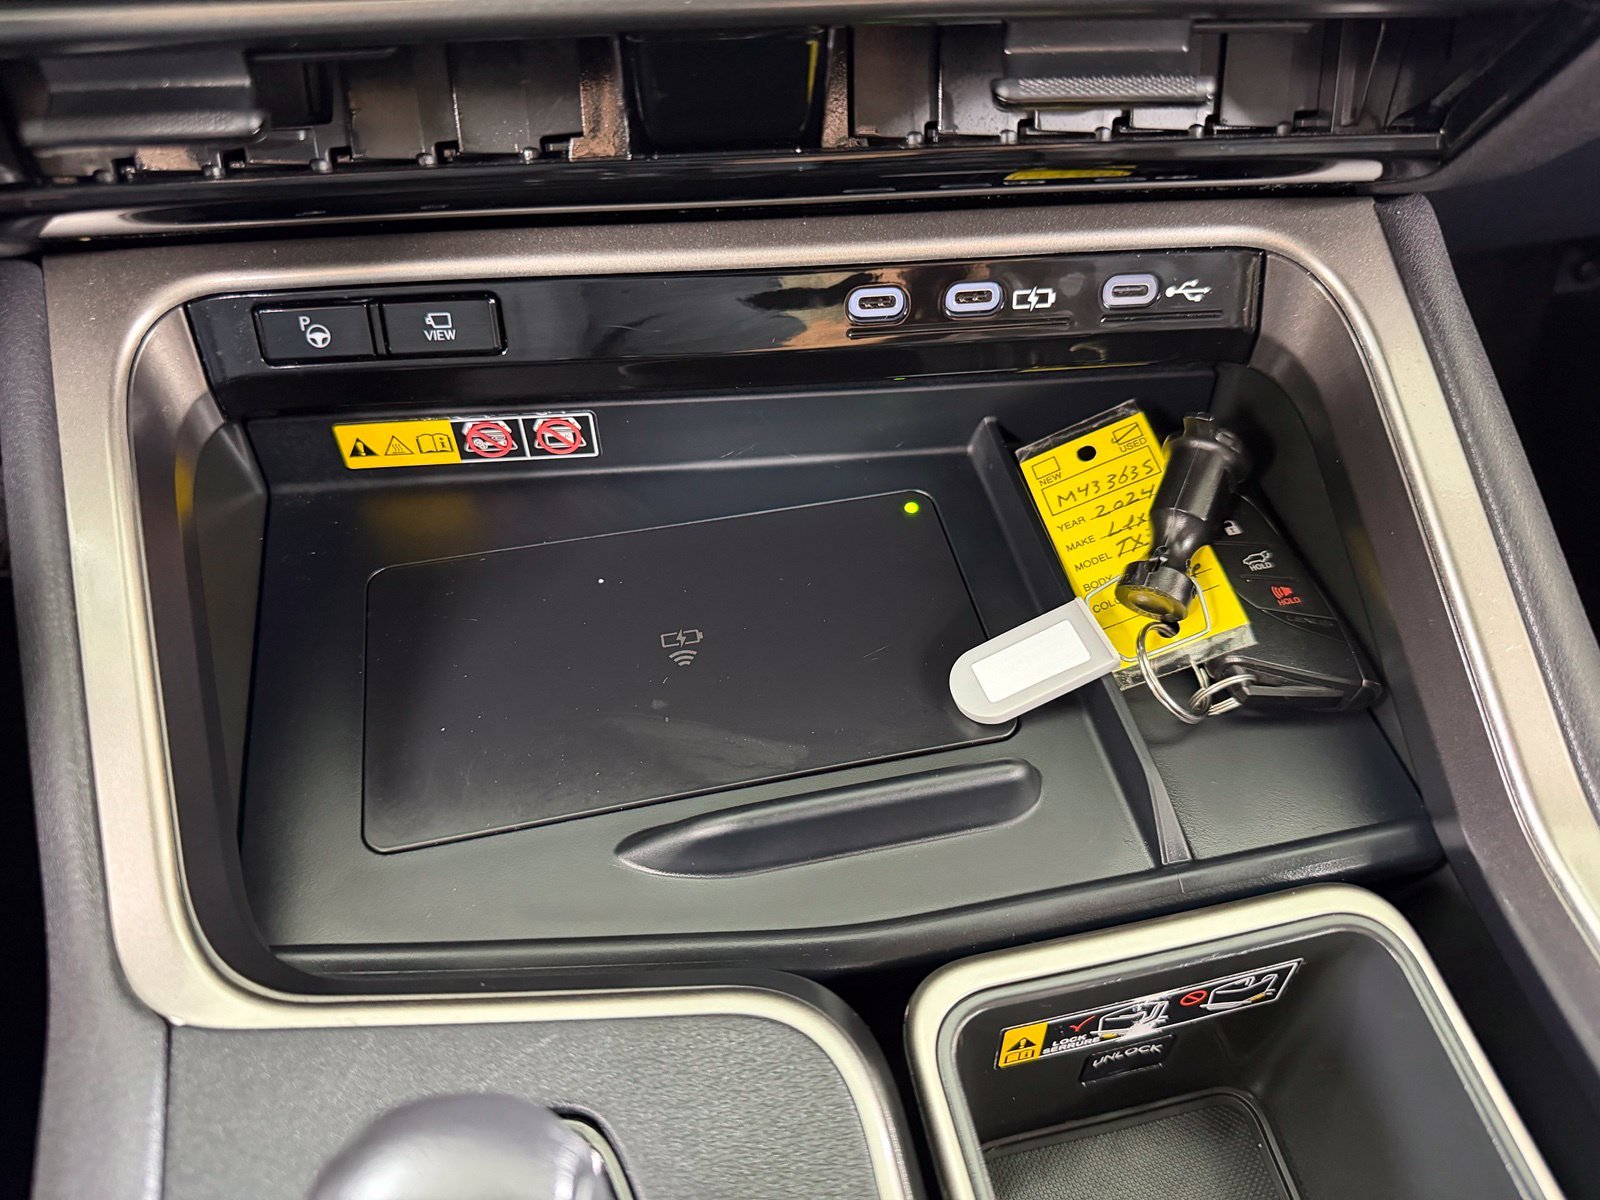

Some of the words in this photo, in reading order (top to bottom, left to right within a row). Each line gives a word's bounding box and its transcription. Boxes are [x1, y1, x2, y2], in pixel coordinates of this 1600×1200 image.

[298, 316, 311, 332] P
[423, 329, 457, 341] VIEW
[1118, 437, 1148, 453] USED
[1039, 472, 1062, 487] NEW
[1057, 516, 1087, 532] YEAR
[1094, 483, 1155, 519] 2024
[1066, 534, 1097, 553] MAKE
[1074, 552, 1113, 573] MODEL
[1249, 562, 1274, 572] HOLD
[1082, 574, 1113, 593] BODY
[1277, 596, 1302, 606] HOLD
[1042, 1036, 1101, 1055] SERRURE
[1051, 1033, 1088, 1048] LOCK
[1092, 1043, 1164, 1069] UNLOCK
